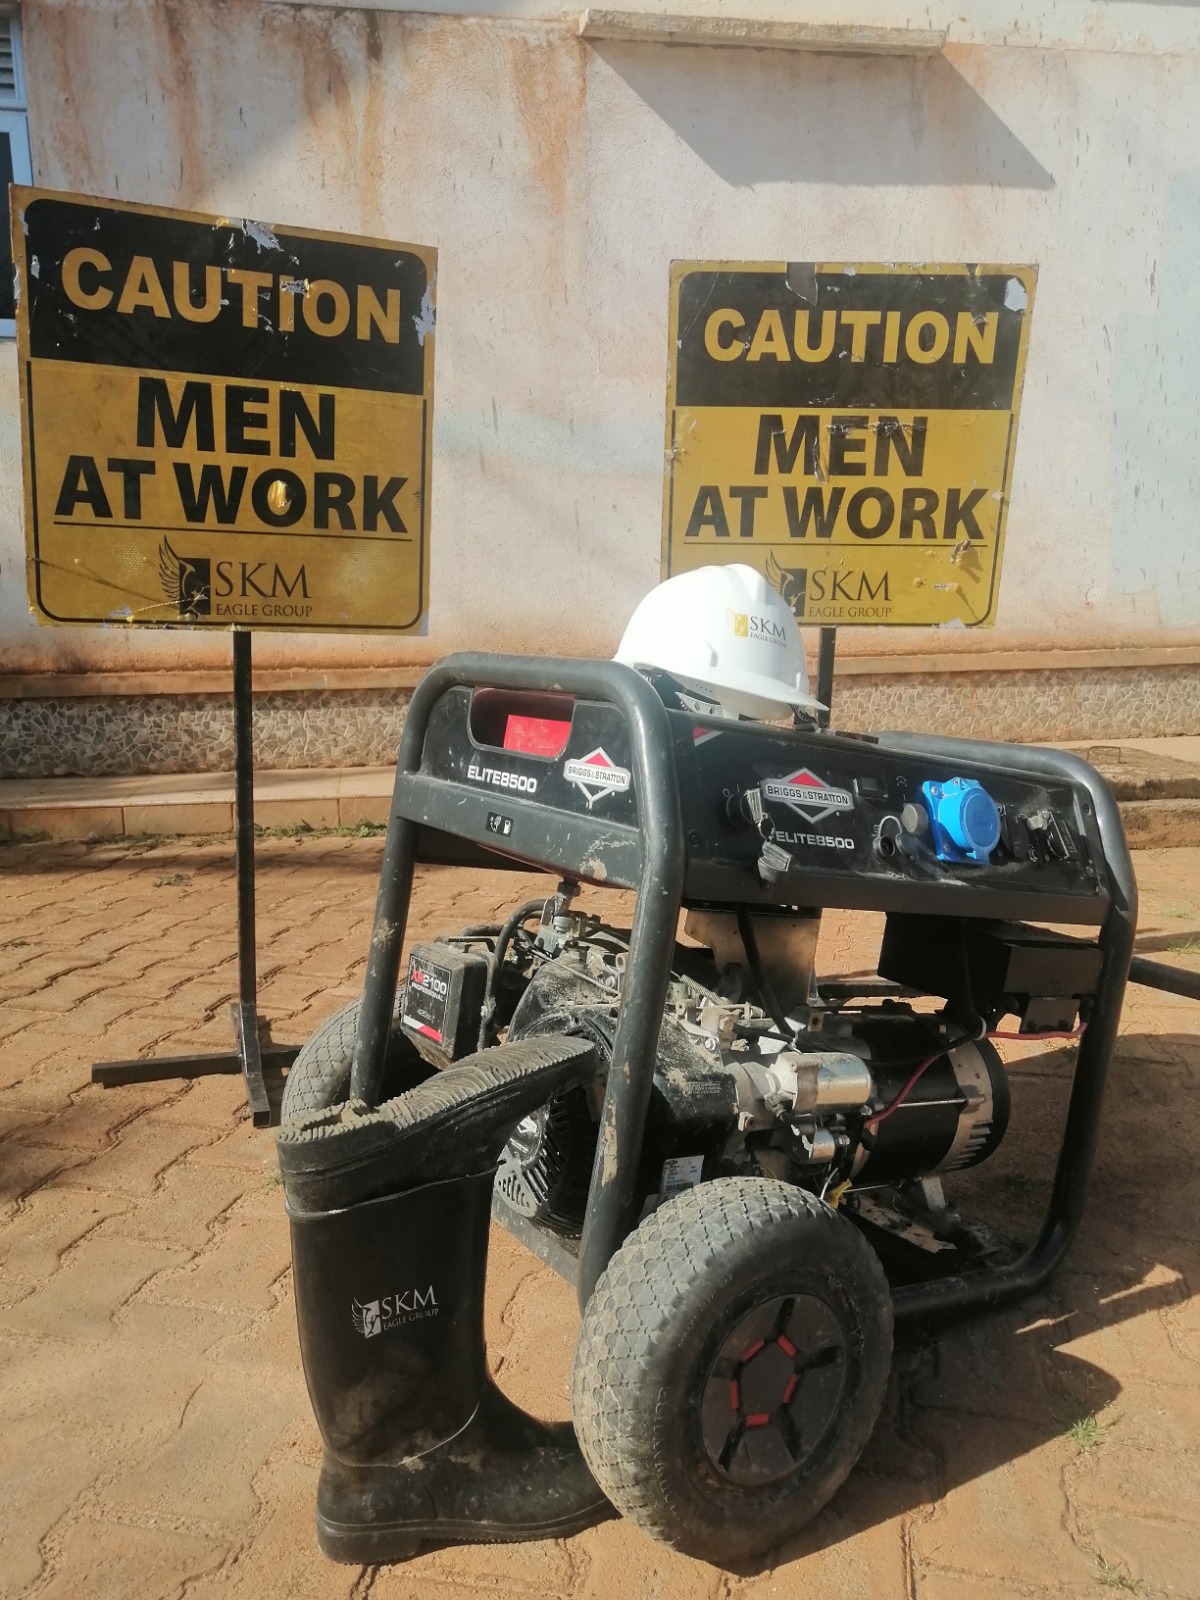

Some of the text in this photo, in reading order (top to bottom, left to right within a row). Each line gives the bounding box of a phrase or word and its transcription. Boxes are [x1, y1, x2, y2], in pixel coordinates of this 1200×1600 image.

[61, 247, 401, 345] CAUTION
[703, 308, 999, 364] CAUTION
[136, 376, 336, 461] MEN
[753, 413, 928, 477] MEN
[54, 454, 409, 534] AT WORK
[684, 485, 989, 540] AT WORK
[215, 561, 313, 599] SKM
[809, 569, 893, 602] SKM
[216, 603, 313, 617] EAGLE GROUP
[809, 606, 892, 618] EAGLE GROUP
[750, 616, 786, 641] SKM
[467, 765, 537, 793] ELITE8500
[776, 831, 855, 849] ELITE8500
[381, 1284, 439, 1320] SKM
[383, 1317, 407, 1331] EAGLE
